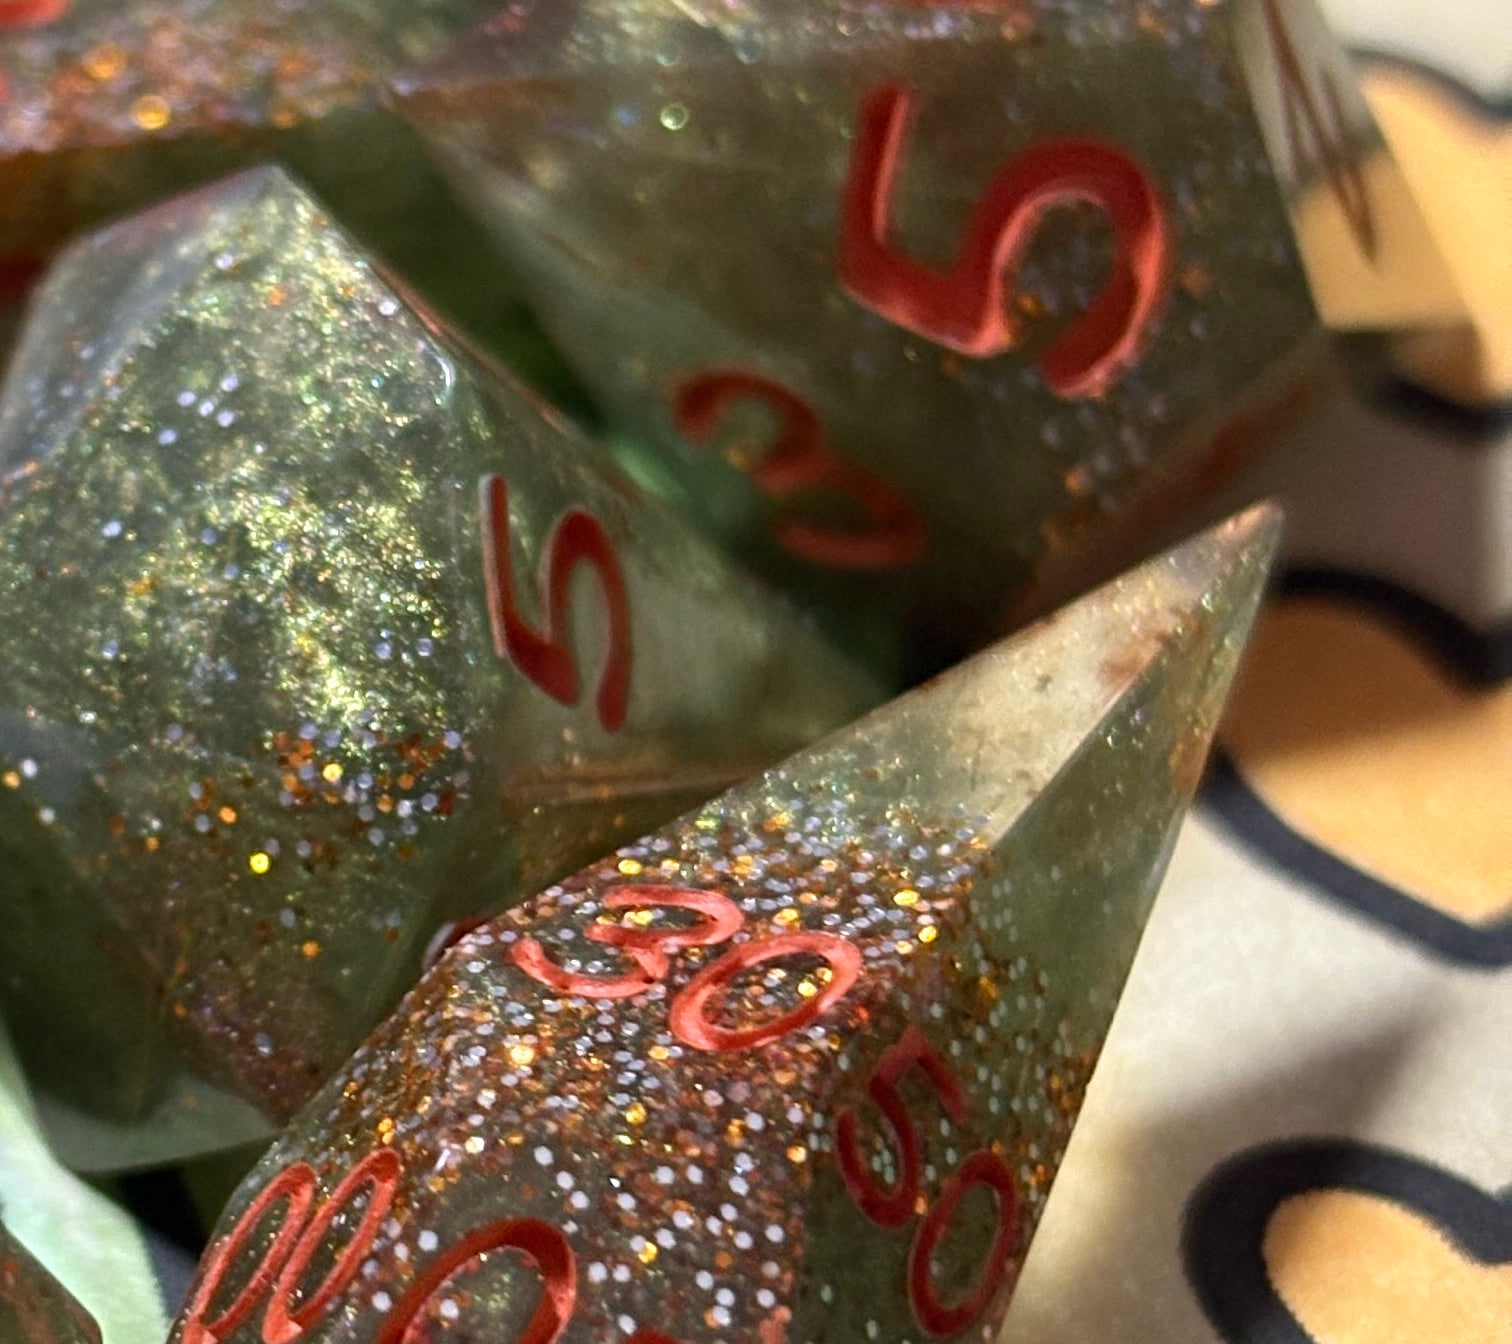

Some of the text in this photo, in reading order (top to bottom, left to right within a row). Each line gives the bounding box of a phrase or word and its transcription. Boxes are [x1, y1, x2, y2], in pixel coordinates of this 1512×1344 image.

[836, 84, 1168, 400] 5
[673, 369, 924, 571] 3
[486, 472, 632, 734] 5
[509, 883, 863, 1053] 30
[835, 1027, 1023, 1338] 50
